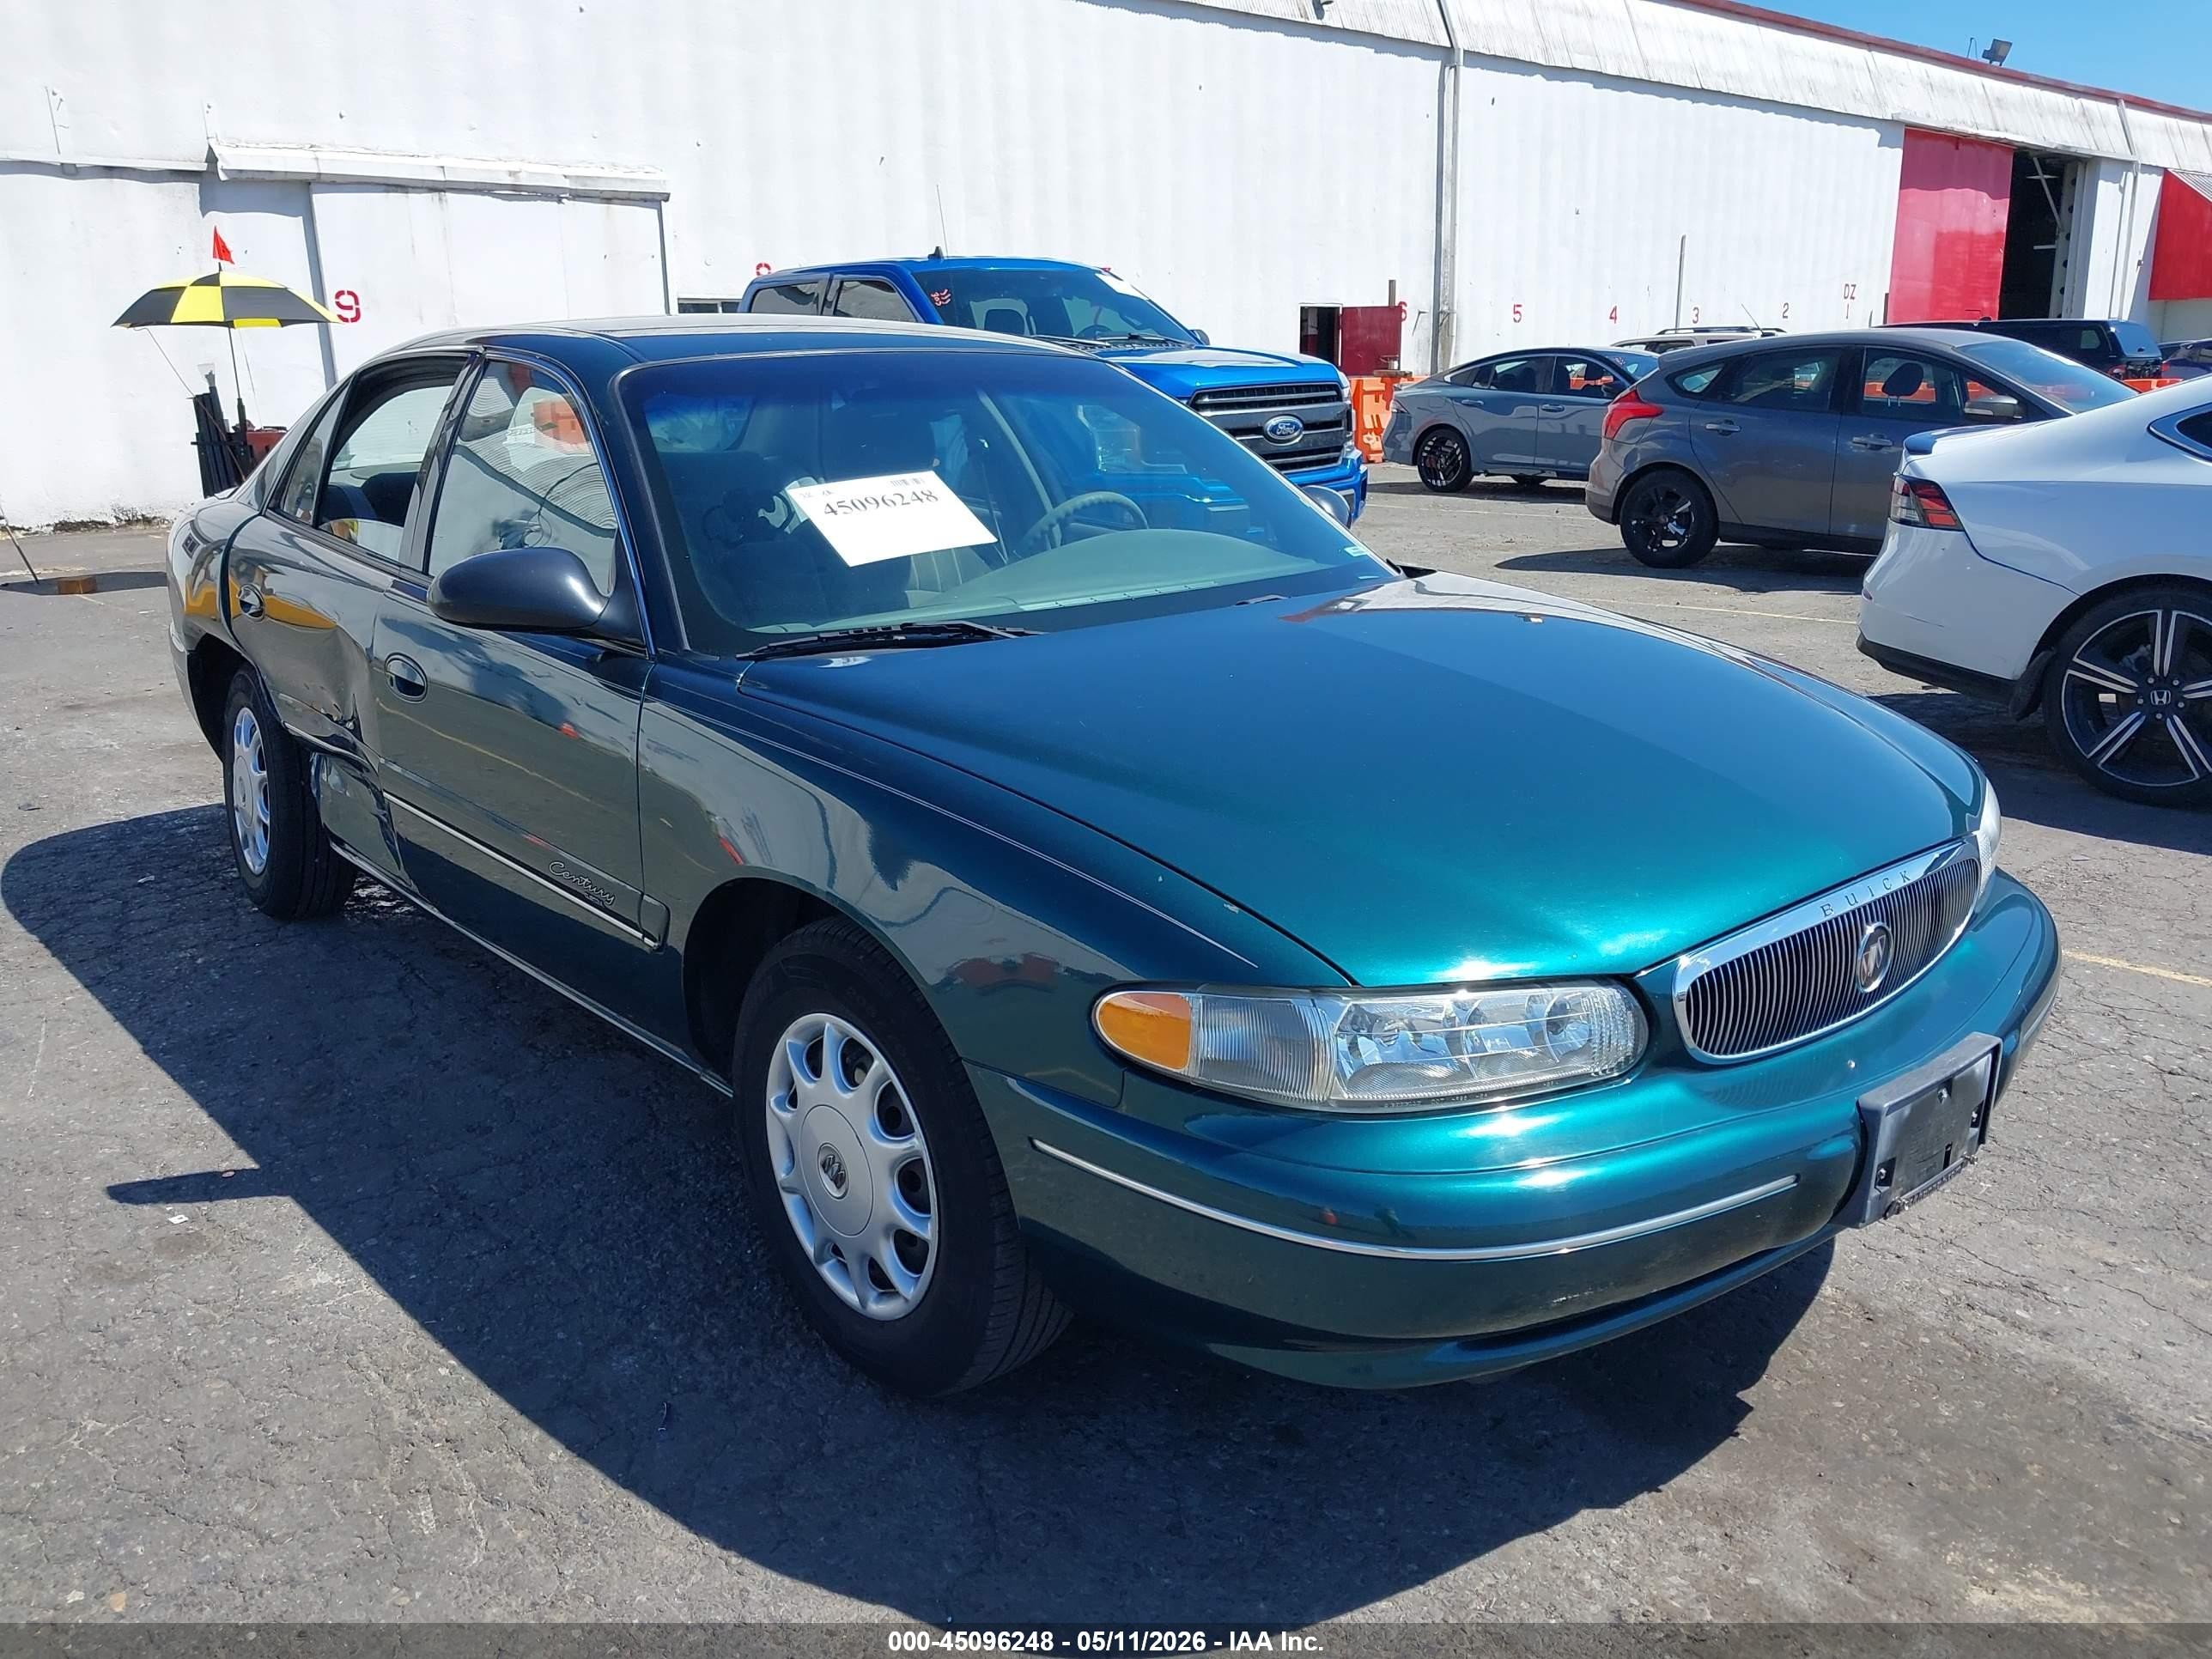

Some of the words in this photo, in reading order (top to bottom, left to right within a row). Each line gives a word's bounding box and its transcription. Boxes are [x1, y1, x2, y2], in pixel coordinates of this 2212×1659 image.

[335, 290, 361, 323] 9
[1513, 303, 1522, 323] 5
[1609, 305, 1618, 324] 4
[1692, 307, 1699, 324] 3
[1782, 302, 1790, 319] 2
[823, 489, 939, 516] 45096248
[550, 860, 616, 906] Century
[1820, 870, 1911, 917] BUICK
